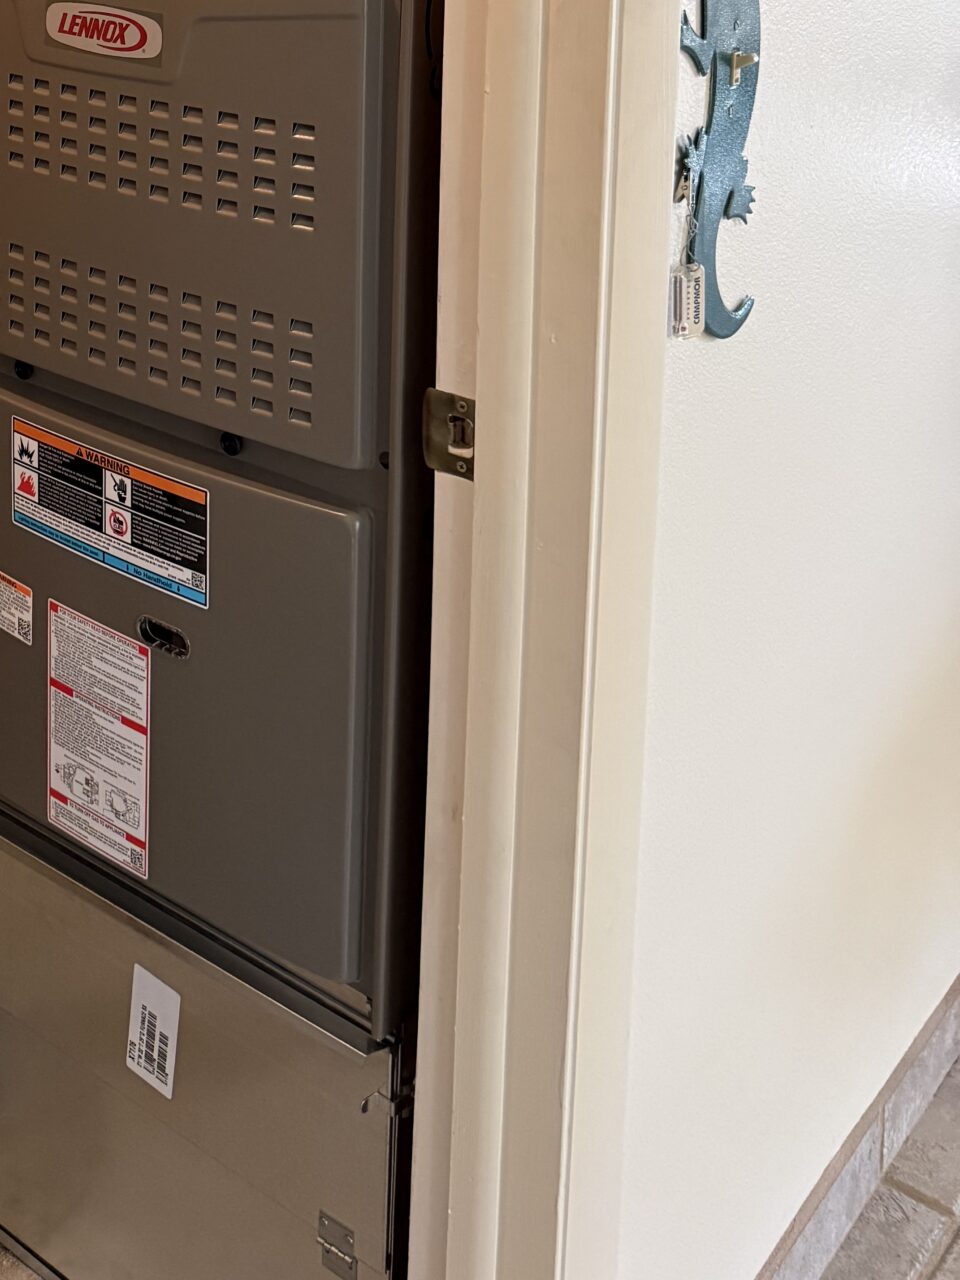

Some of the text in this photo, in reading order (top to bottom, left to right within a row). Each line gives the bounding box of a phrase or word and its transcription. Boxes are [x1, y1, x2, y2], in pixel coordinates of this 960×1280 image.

[58, 13, 131, 45] LENNOX
[84, 449, 131, 476] WARNING
[133, 567, 142, 577] No
